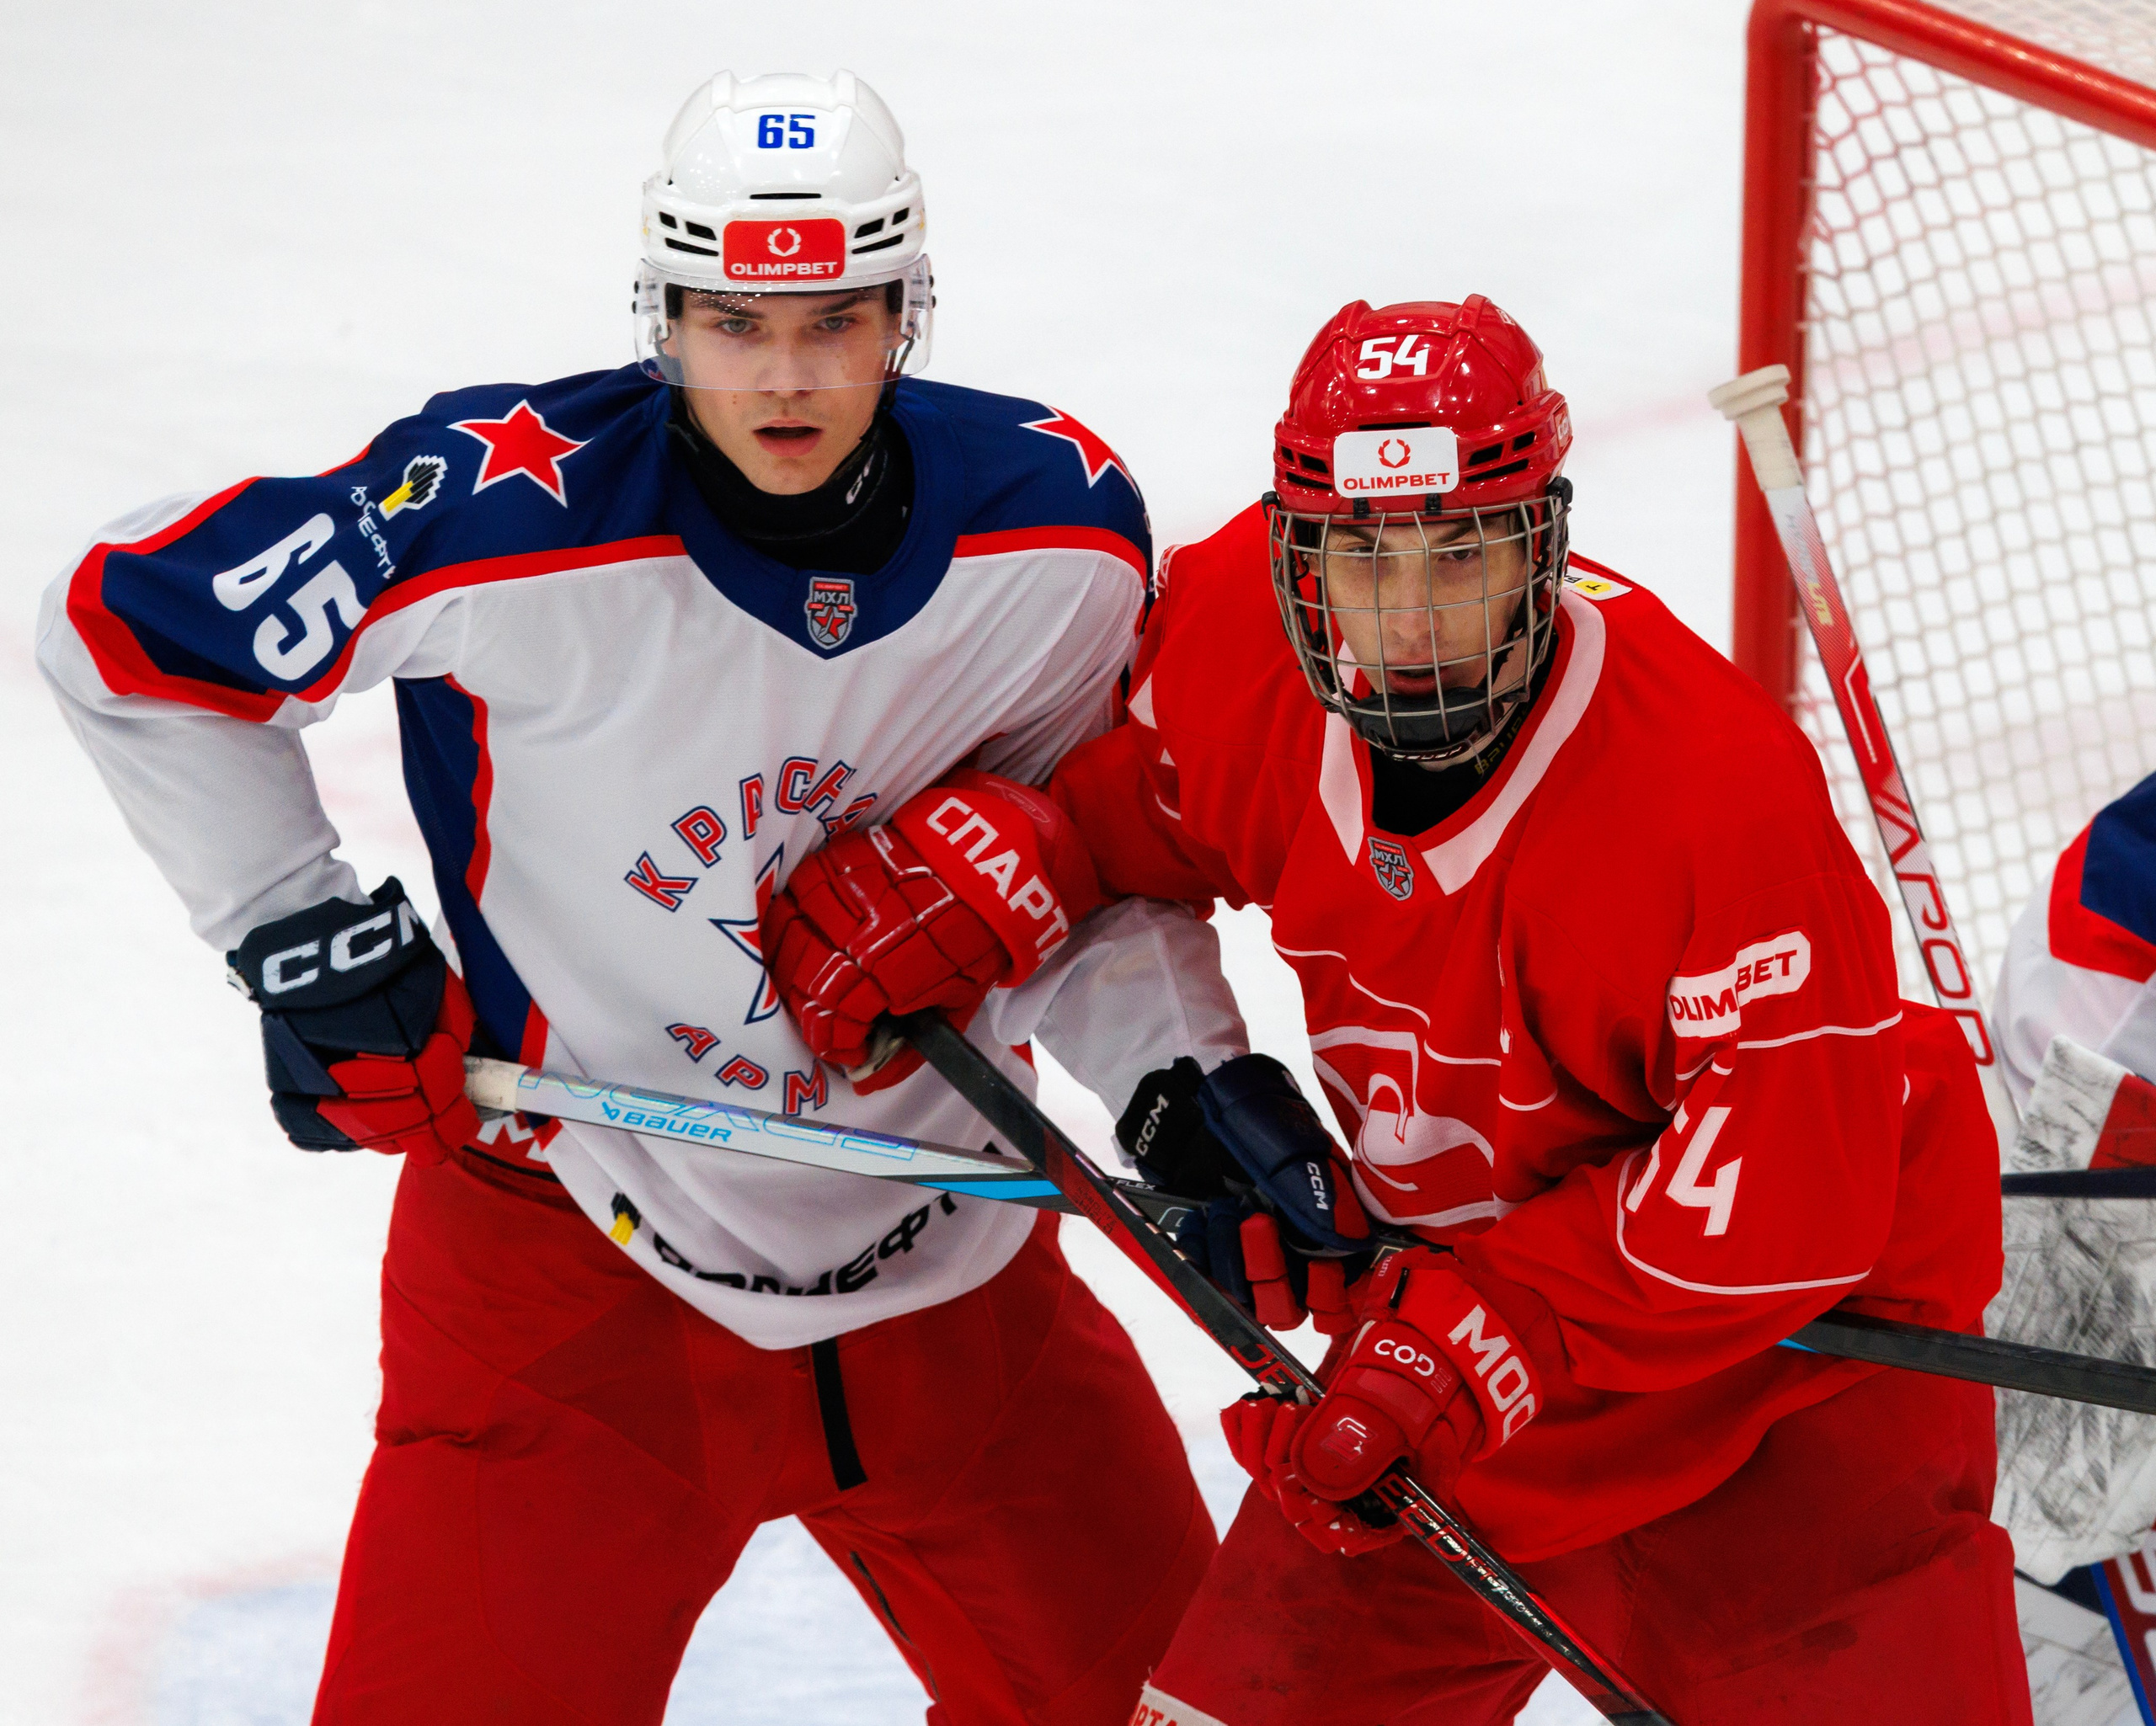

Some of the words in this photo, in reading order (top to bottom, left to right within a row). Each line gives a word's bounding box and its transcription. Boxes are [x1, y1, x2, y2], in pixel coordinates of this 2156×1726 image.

[757, 113, 816, 150] 65
[730, 260, 838, 276] OLIMPBET
[1357, 334, 1430, 381] 54
[1343, 471, 1451, 491] OLIMPBET
[212, 512, 369, 681] 65
[814, 590, 850, 605] МХЛ
[1668, 948, 1798, 1022] OLIMBET
[622, 1111, 733, 1143] BAUER
[1134, 1093, 1170, 1157] CCM
[1116, 1180, 1156, 1191] FLEX
[1306, 1161, 1329, 1211] CCM
